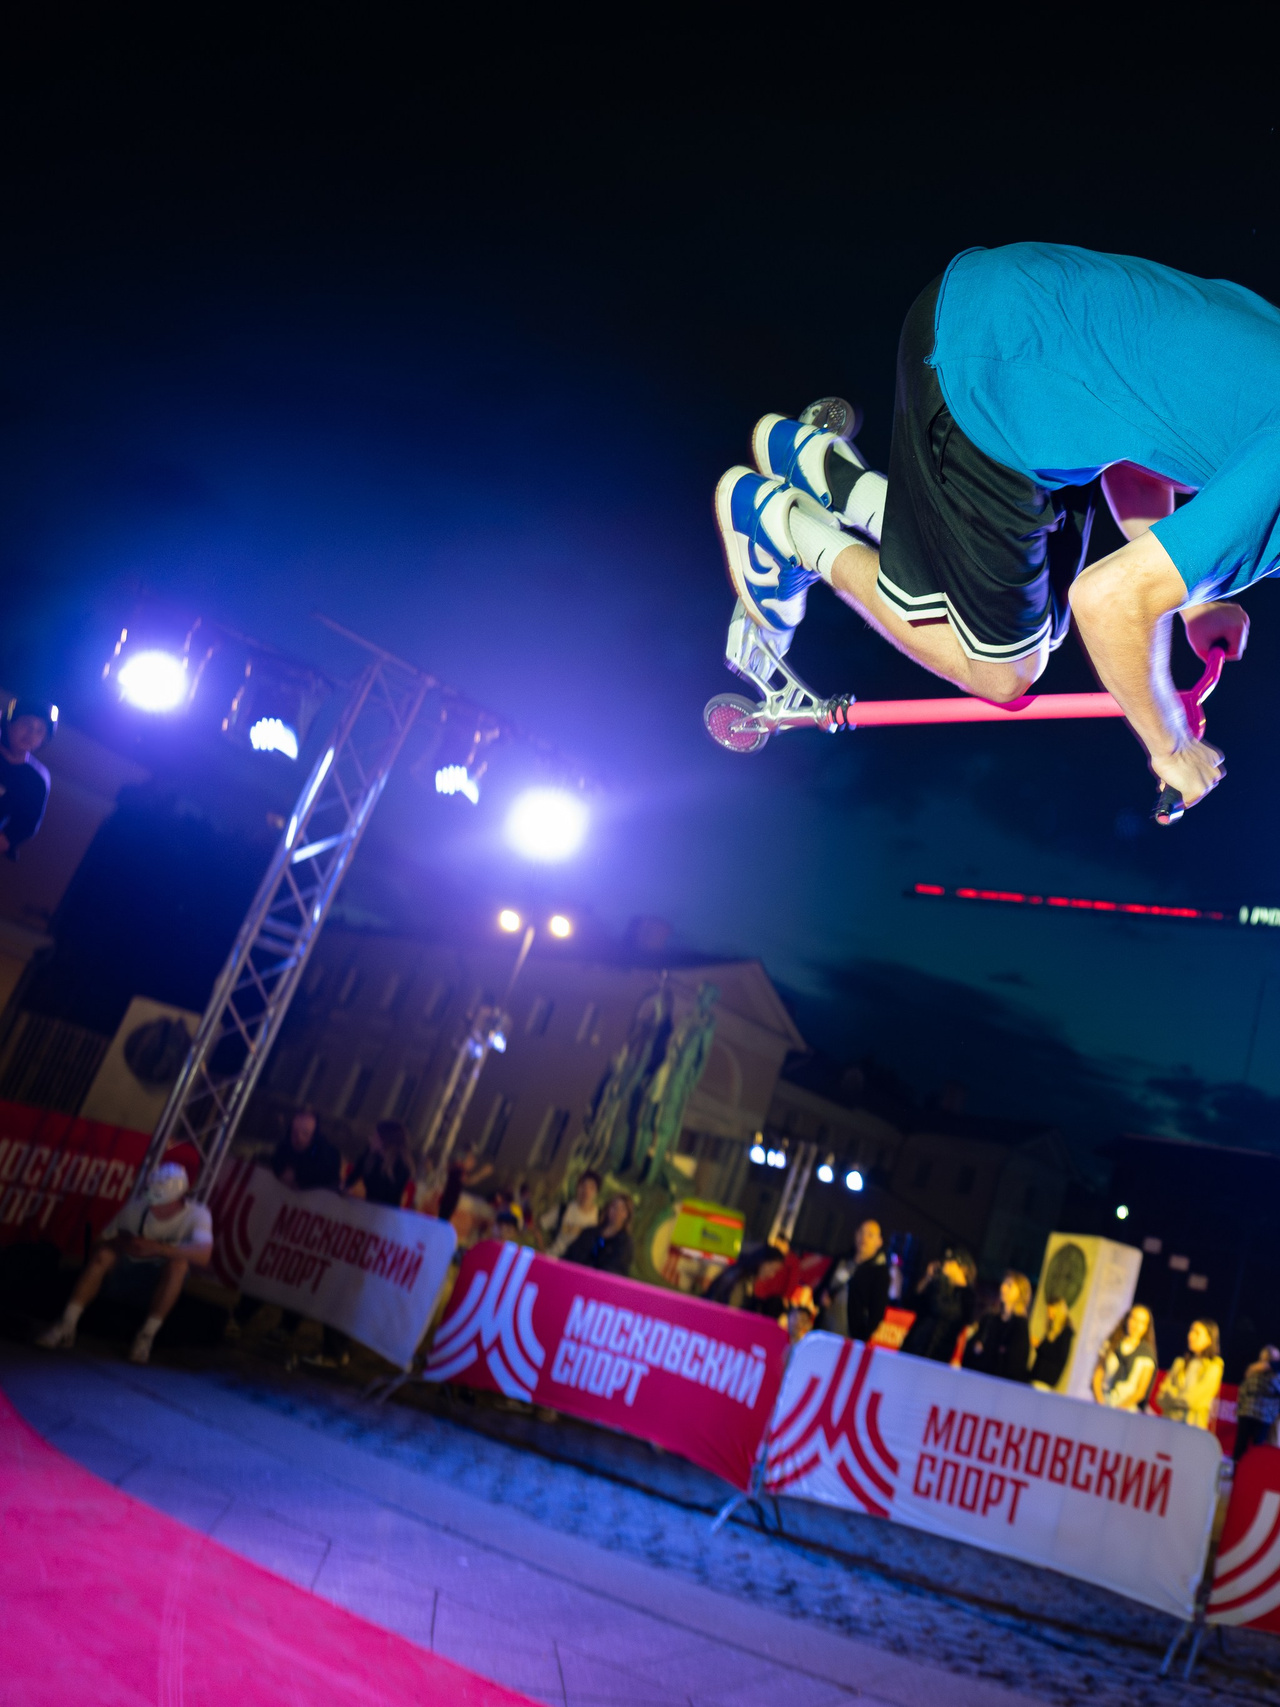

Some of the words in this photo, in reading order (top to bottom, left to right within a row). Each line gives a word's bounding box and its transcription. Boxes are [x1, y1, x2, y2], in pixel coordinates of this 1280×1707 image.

[254, 1240, 333, 1295] СПОРТ
[270, 1203, 426, 1294] МОСКОВСКИЙ
[551, 1338, 649, 1408] СПОРТ
[563, 1294, 767, 1410] МОСКОВСКИЙ
[912, 1451, 1030, 1527] СПОРТ
[922, 1404, 1174, 1518] МОСКОВСКИЙ
